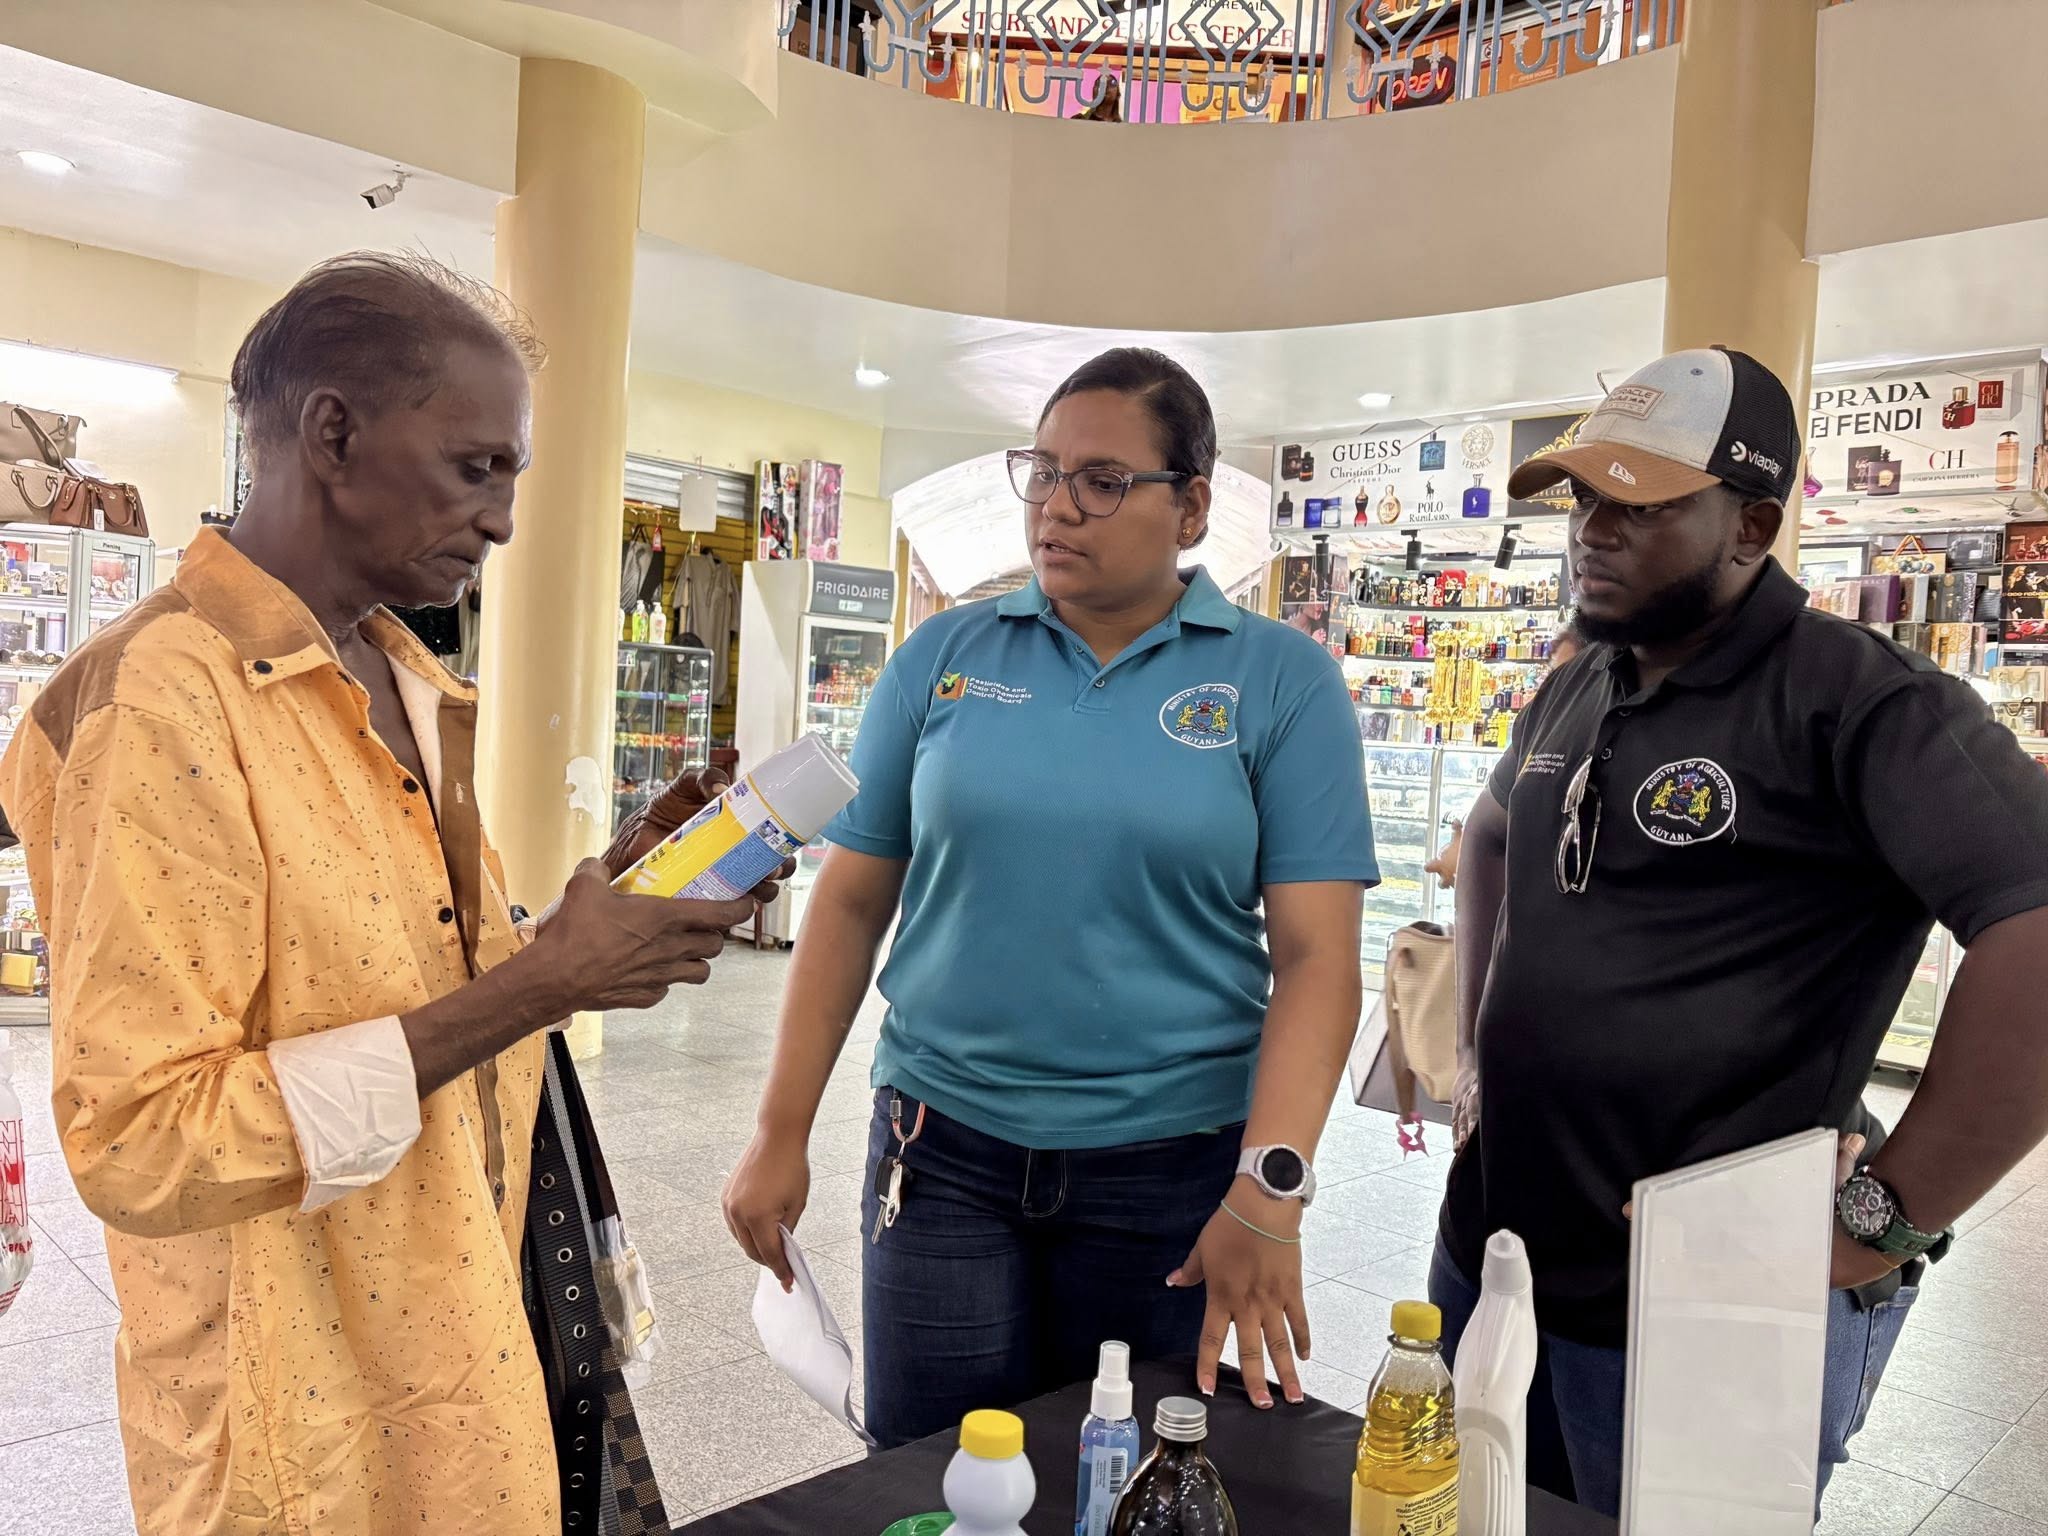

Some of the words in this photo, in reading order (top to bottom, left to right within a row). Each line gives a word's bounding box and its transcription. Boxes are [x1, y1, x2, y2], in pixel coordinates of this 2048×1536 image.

[961, 11, 1037, 32] STORE
[1043, 15, 1090, 35] AND
[1101, 17, 1197, 42] SERVCE
[1206, 24, 1296, 48] CENTER
[1391, 66, 1448, 102] OPEN
[1813, 381, 1931, 410] PRADA
[1836, 407, 1923, 436] FENDI
[1332, 439, 1402, 463] GUESS
[1929, 448, 1966, 470] CH
[1330, 466, 1374, 479] Christian
[1378, 463, 1402, 475] Dior
[1462, 455, 1493, 470] VERSACE
[1748, 450, 1783, 479] viaplay
[1417, 501, 1444, 514] POLO
[815, 580, 889, 601] FRIGIDAIRE
[996, 696, 1022, 705] Board
[1167, 690, 1196, 711] MINISTRY
[1180, 733, 1218, 746] GUYANA
[1646, 765, 1682, 791] MINISTRY
[1685, 761, 1697, 769] OF
[1697, 762, 1731, 811] AGRICULTURE
[1650, 825, 1693, 842] GUYANA
